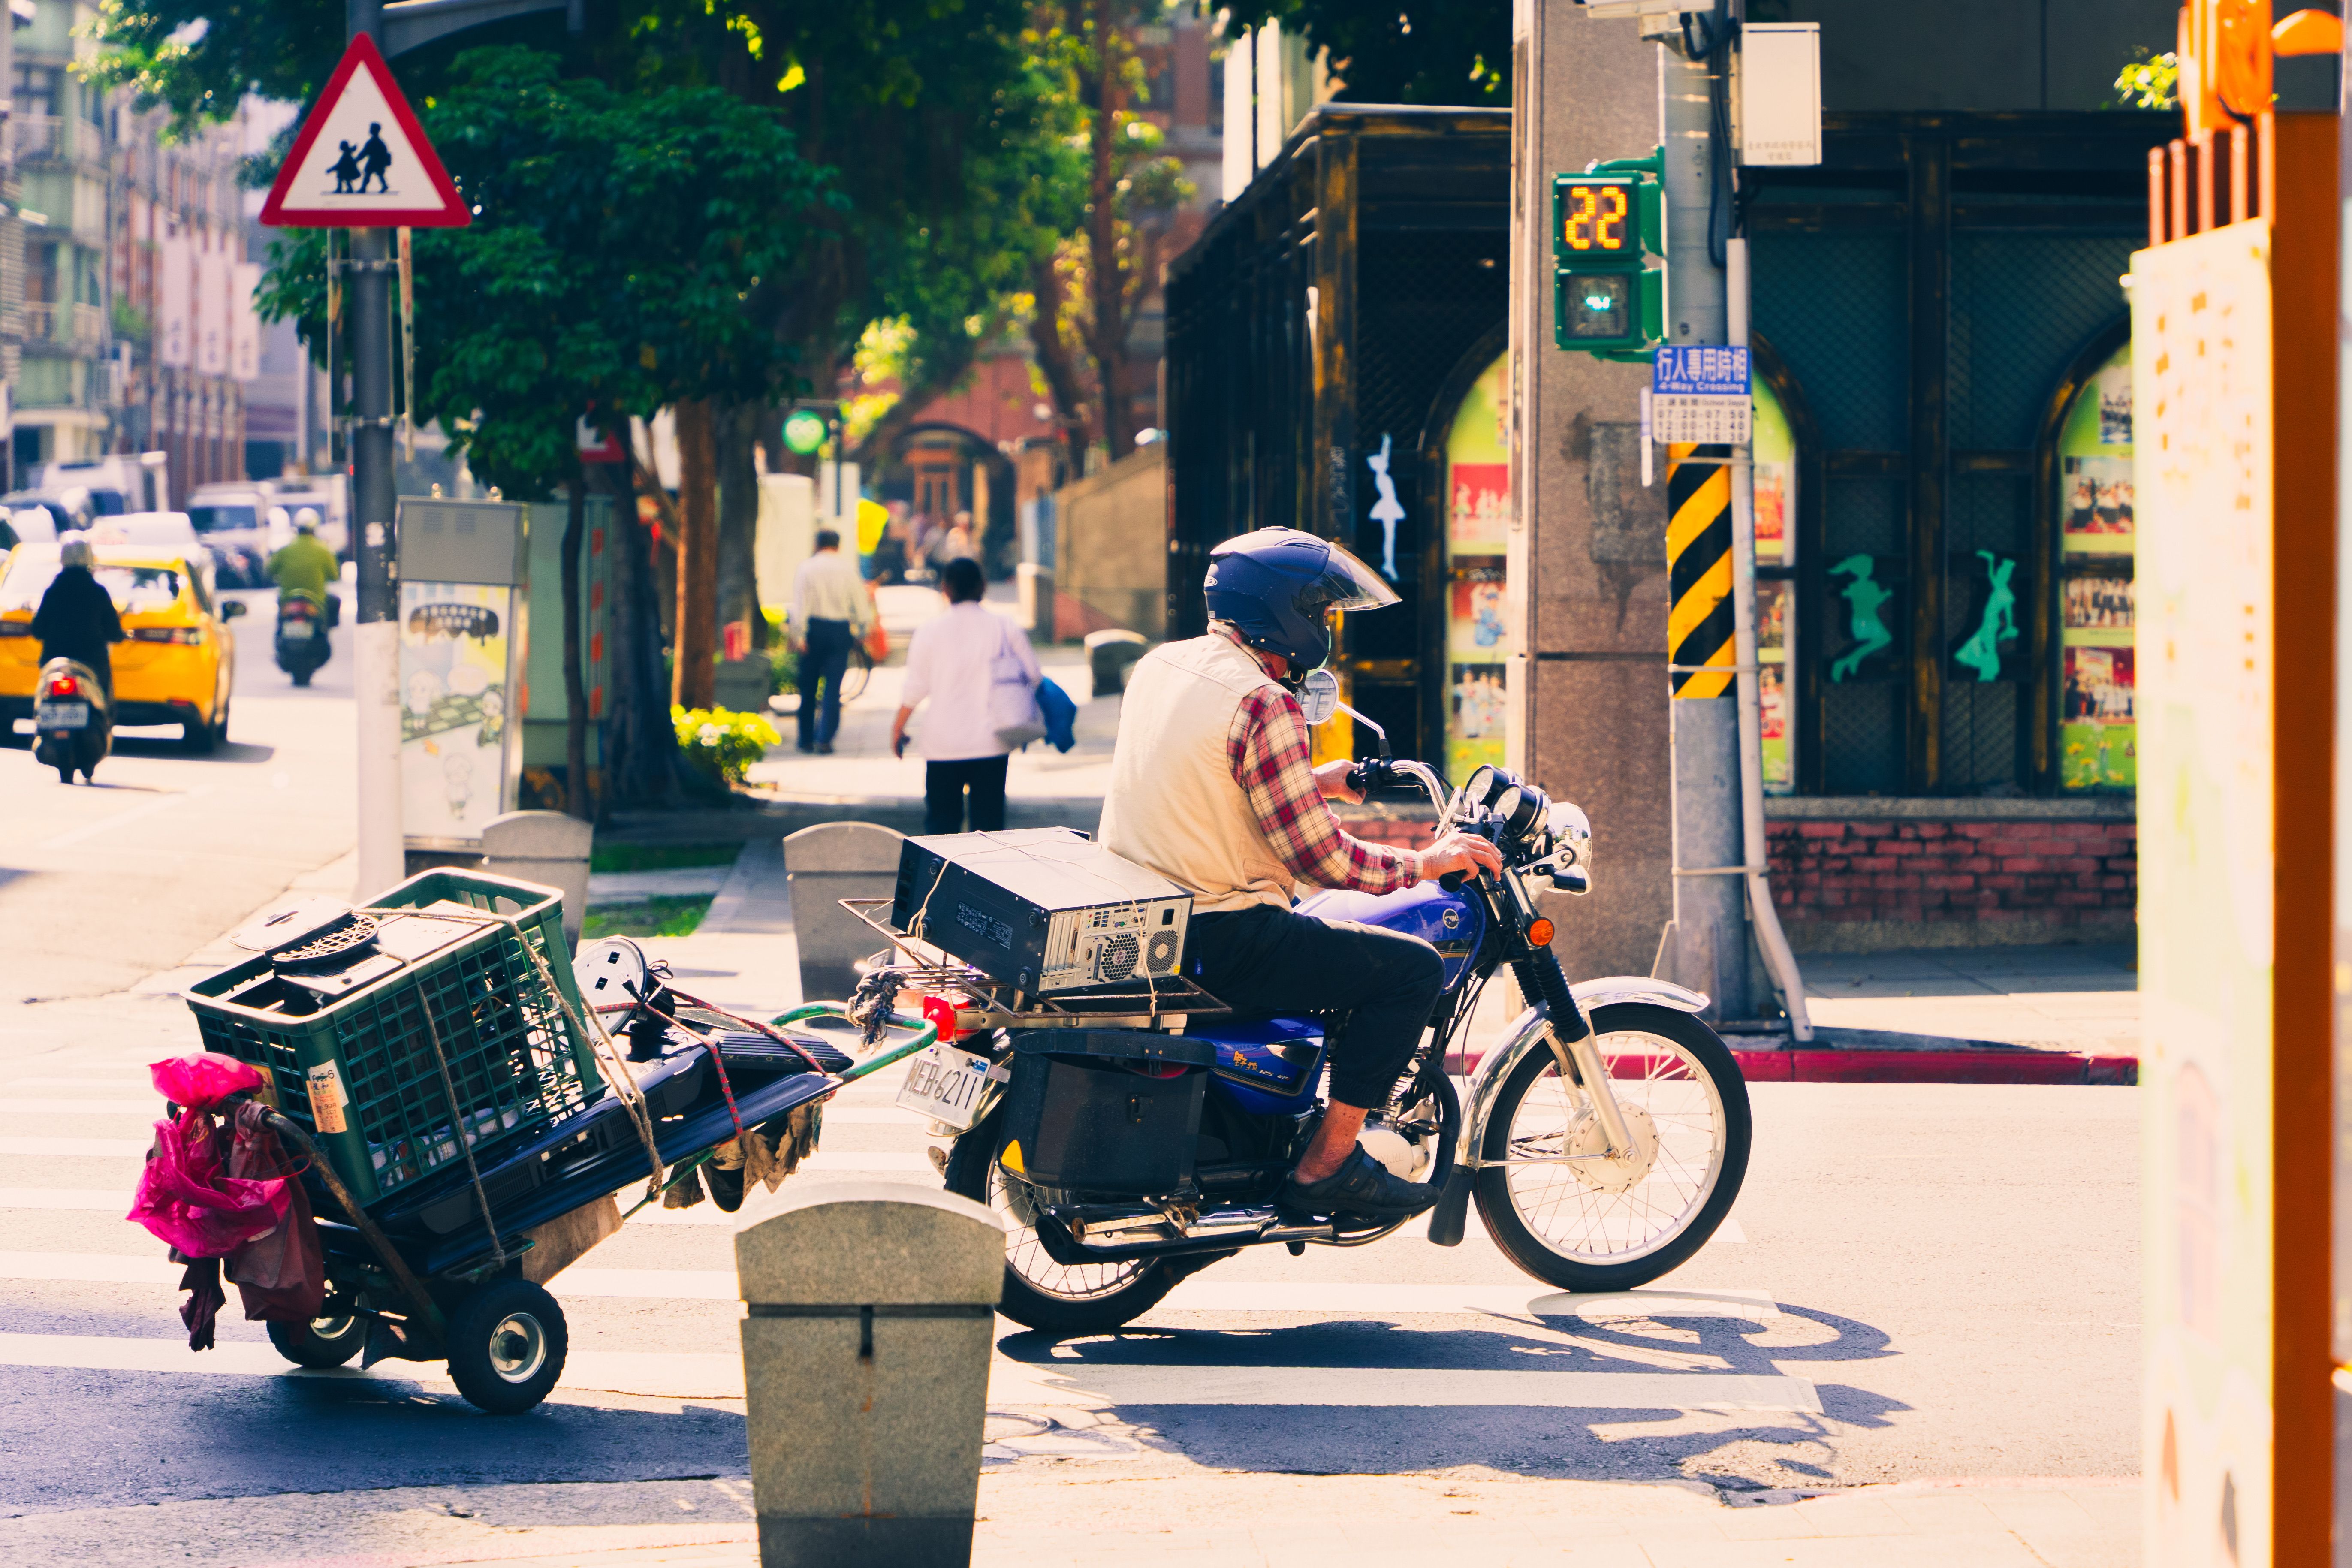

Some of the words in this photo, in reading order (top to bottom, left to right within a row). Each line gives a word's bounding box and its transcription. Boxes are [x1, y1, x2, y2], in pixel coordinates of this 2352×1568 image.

[1565, 186, 1627, 250] 22
[1657, 348, 1747, 382] 行人專用時相
[1658, 381, 1694, 392] 4-Way
[1696, 381, 1745, 393] Crossing
[1233, 1051, 1258, 1072] 野狼
